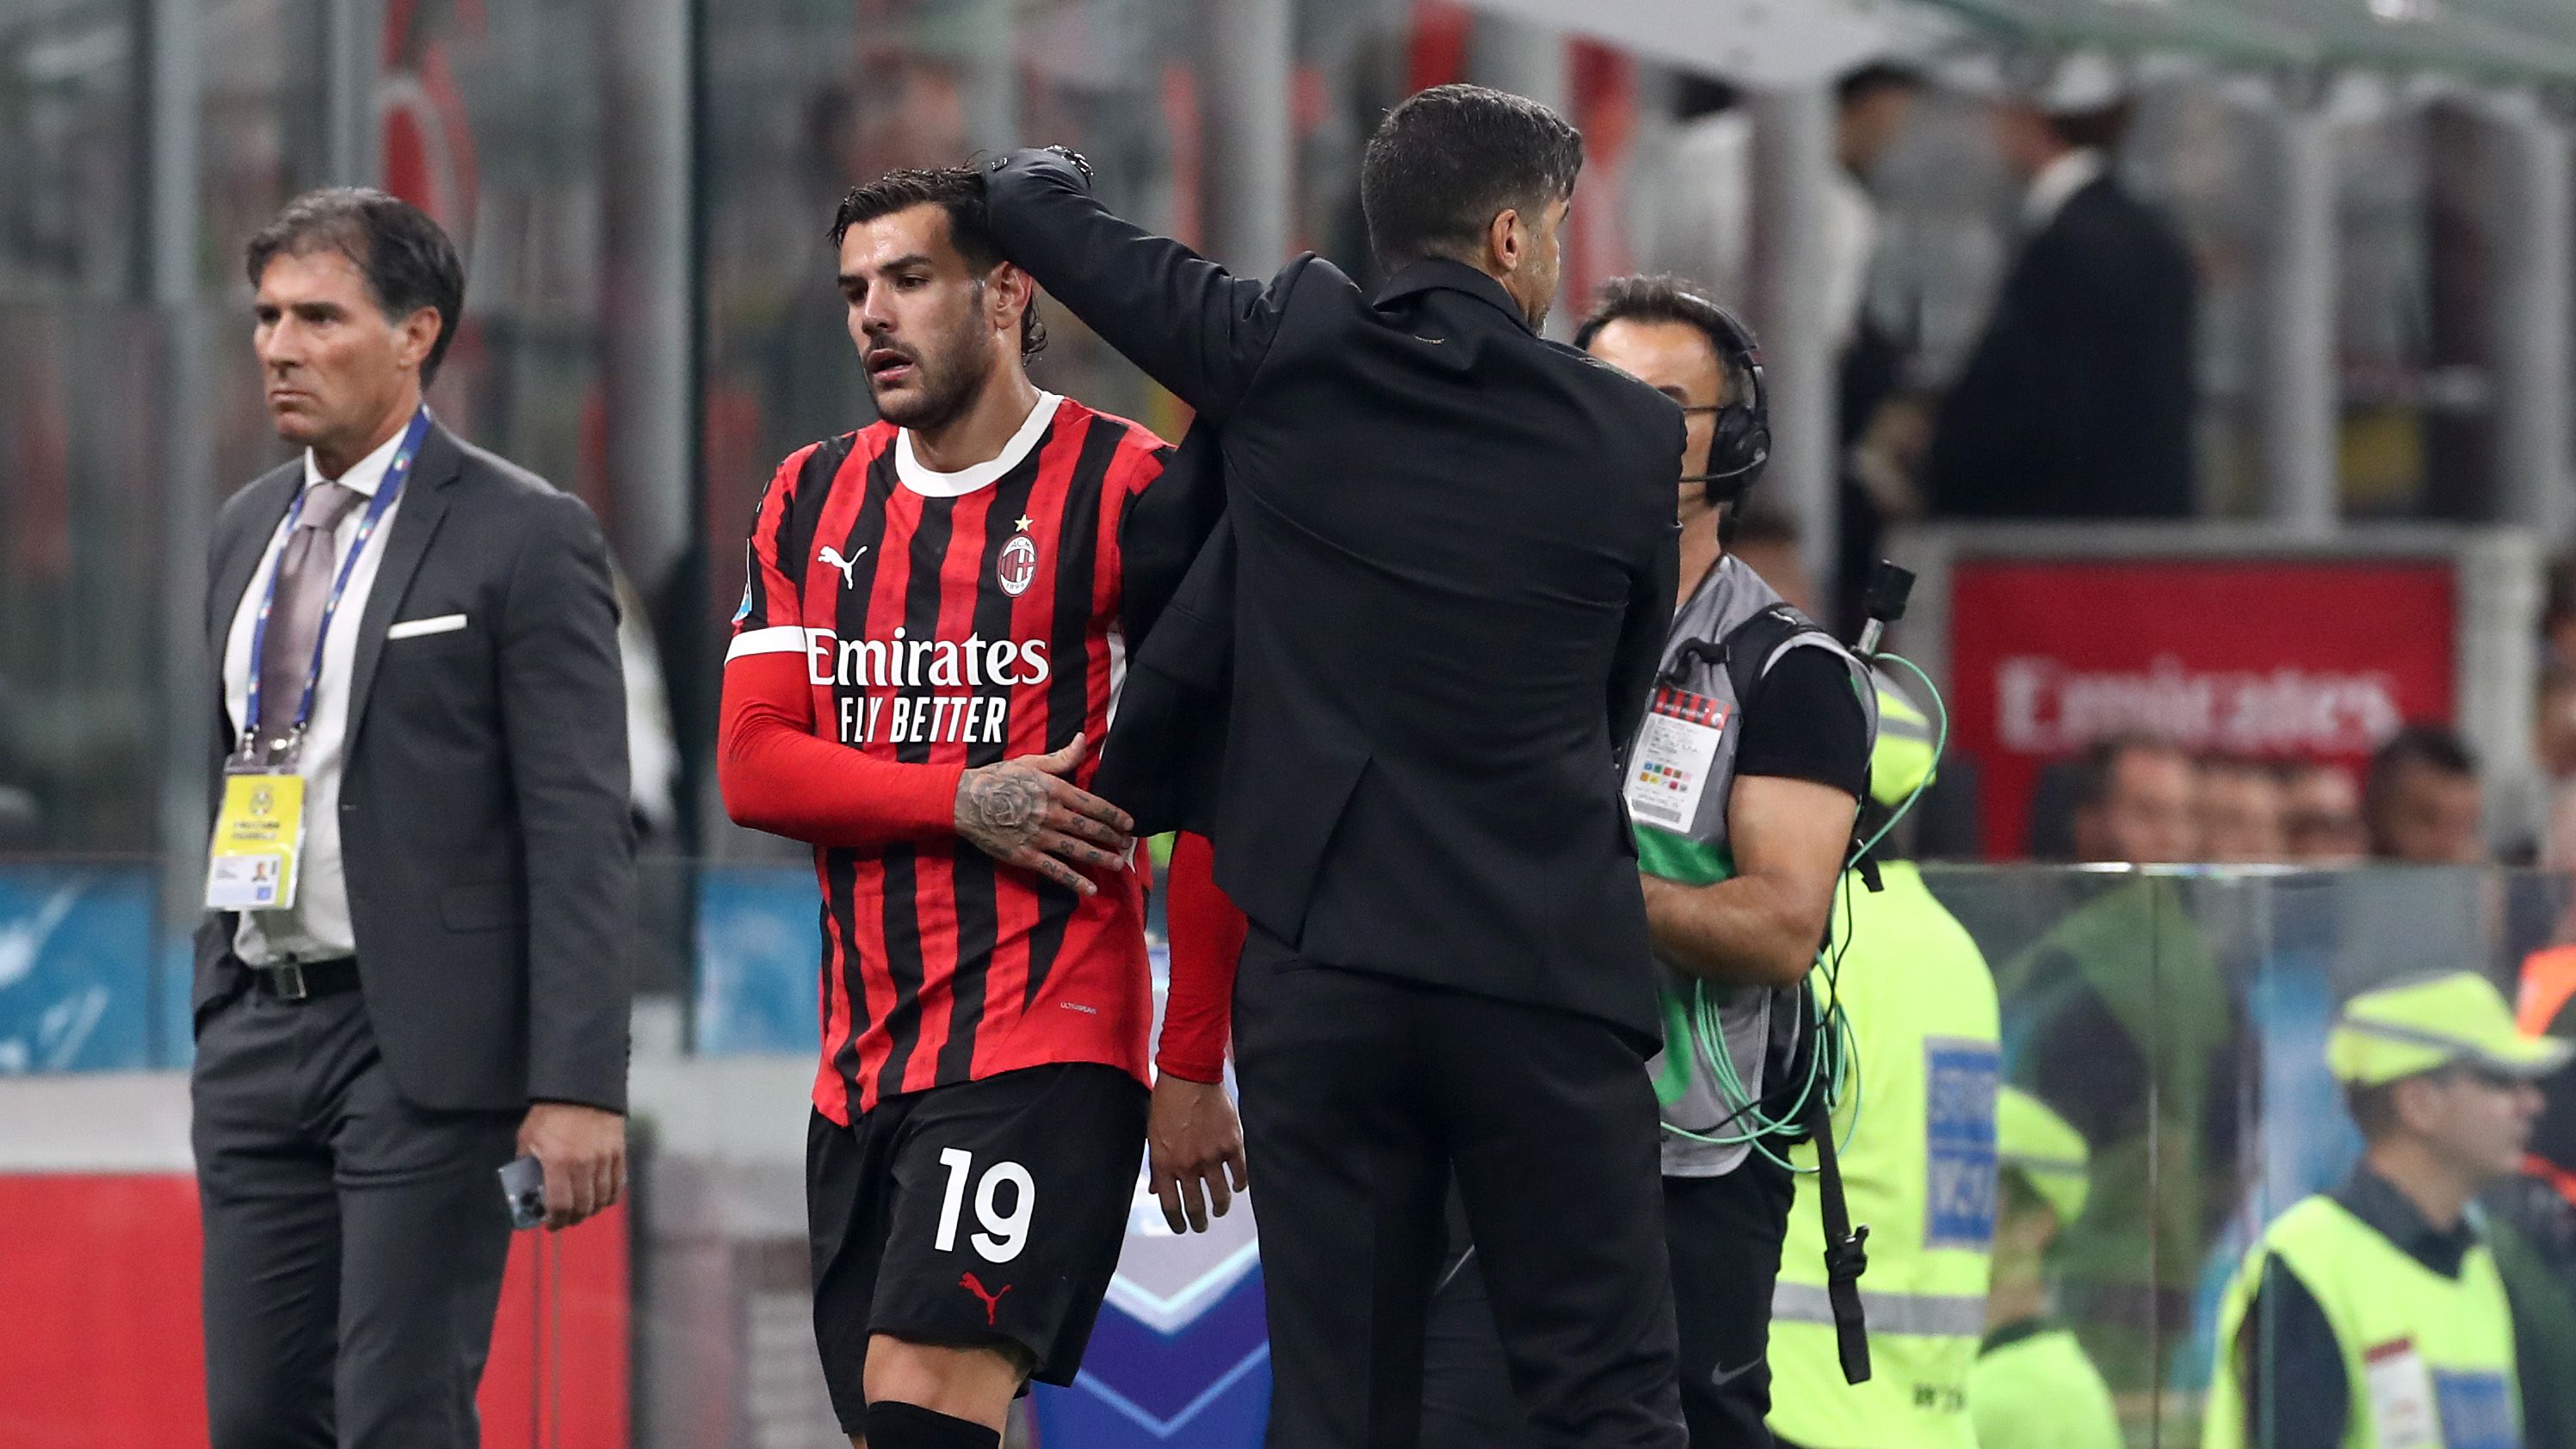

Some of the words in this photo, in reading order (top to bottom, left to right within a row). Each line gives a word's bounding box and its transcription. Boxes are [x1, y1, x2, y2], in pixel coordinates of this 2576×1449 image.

[806, 626, 1051, 687] Emirates
[840, 696, 882, 743] FLY
[889, 696, 1008, 743] BETTER
[935, 1147, 1035, 1263] 19
